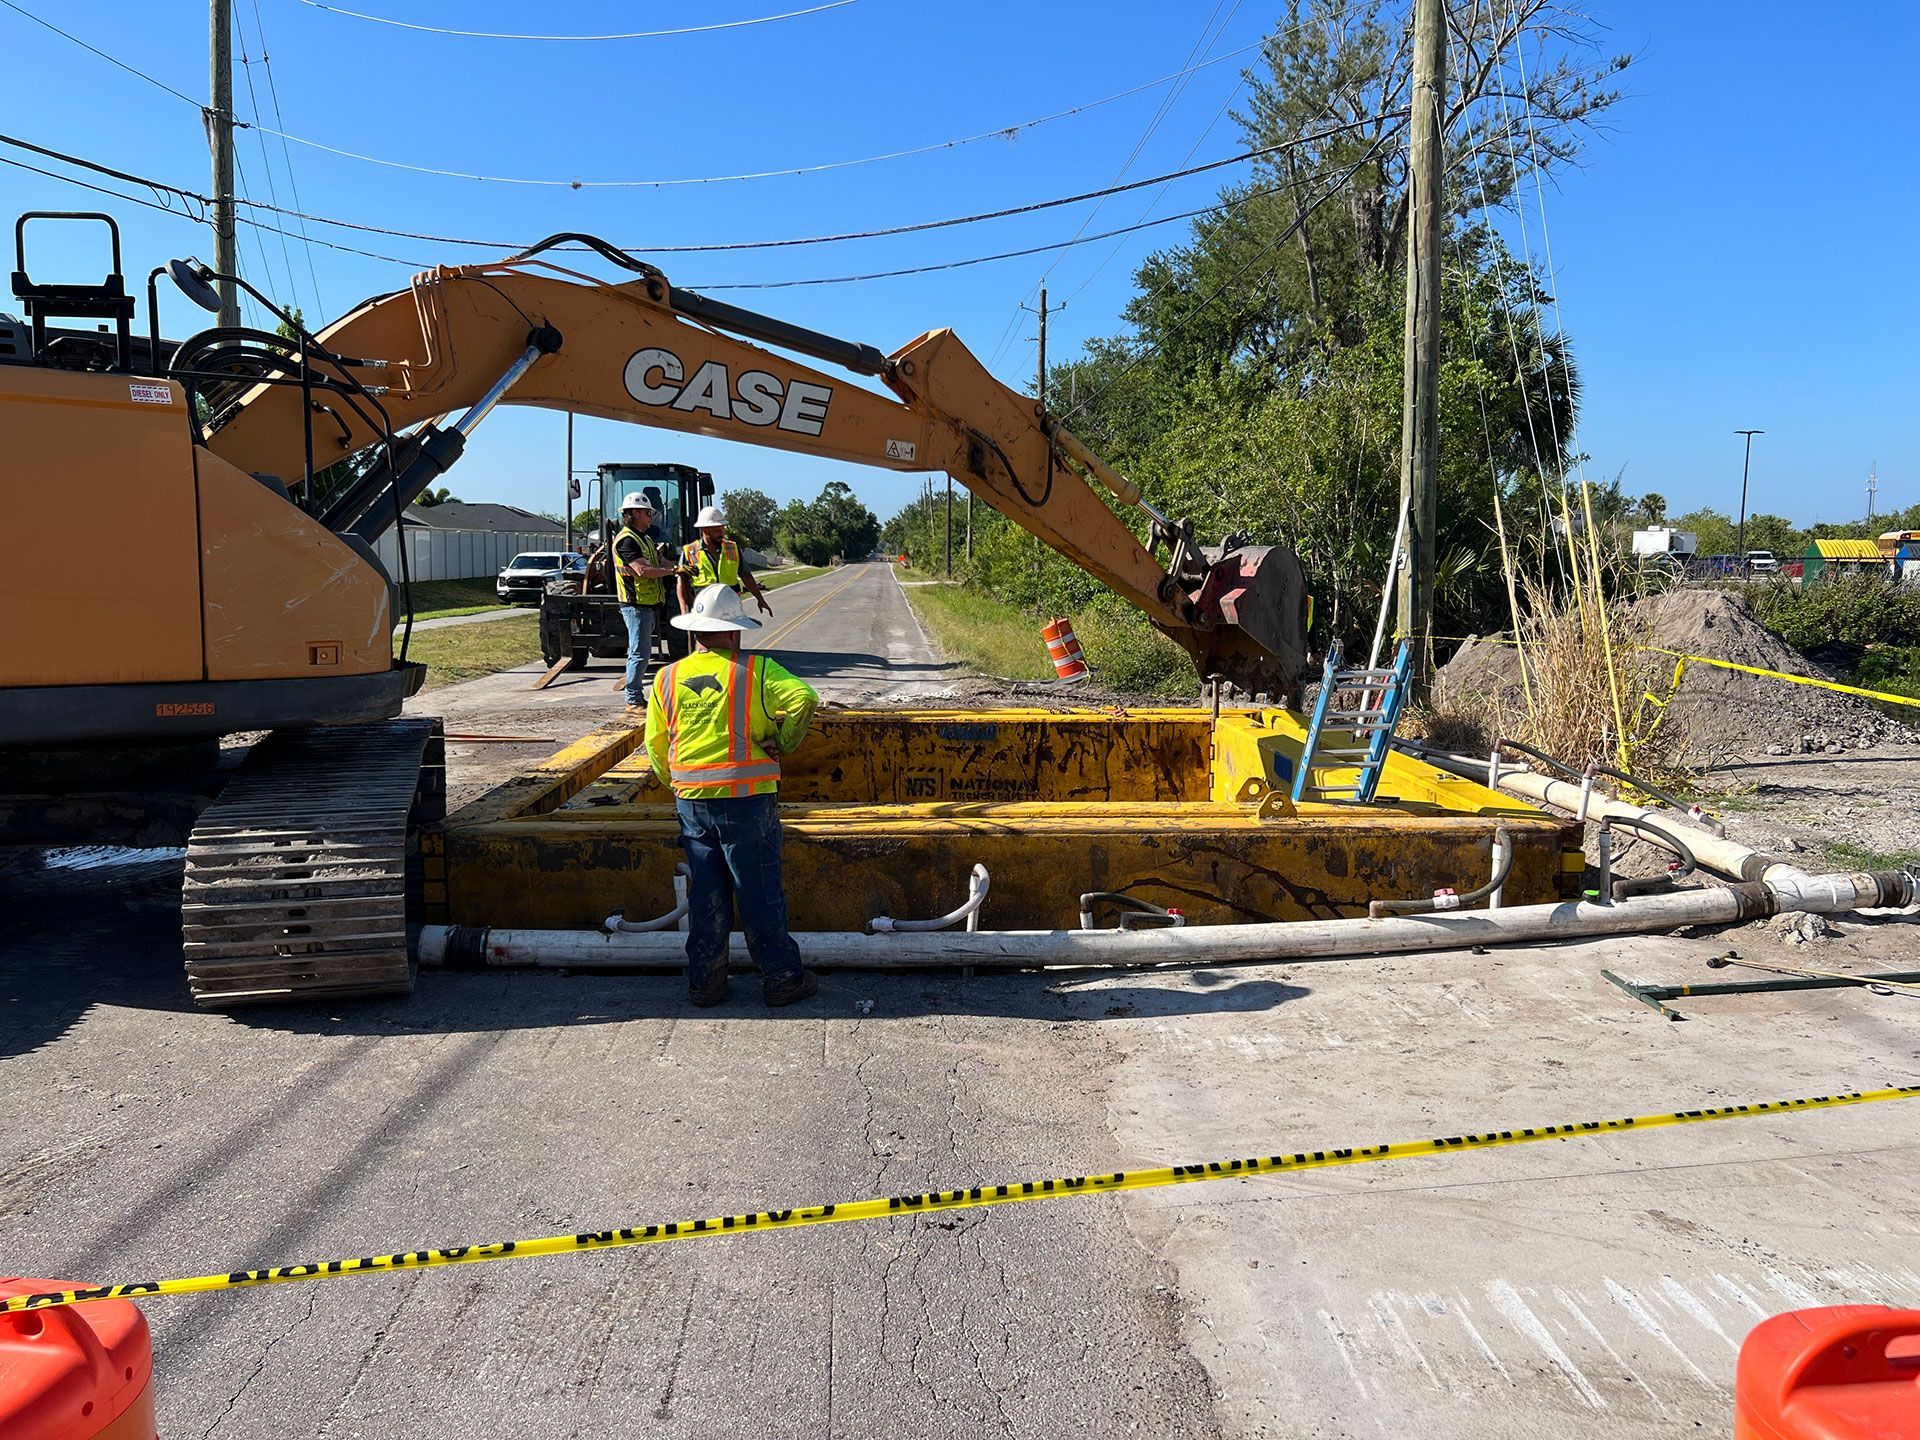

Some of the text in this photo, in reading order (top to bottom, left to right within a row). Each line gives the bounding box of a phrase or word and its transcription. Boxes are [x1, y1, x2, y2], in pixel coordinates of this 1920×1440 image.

[132, 389, 169, 399] DIESEL ONLY
[623, 347, 834, 438] CASE
[157, 703, 214, 716] 192556
[906, 778, 936, 797] NTS
